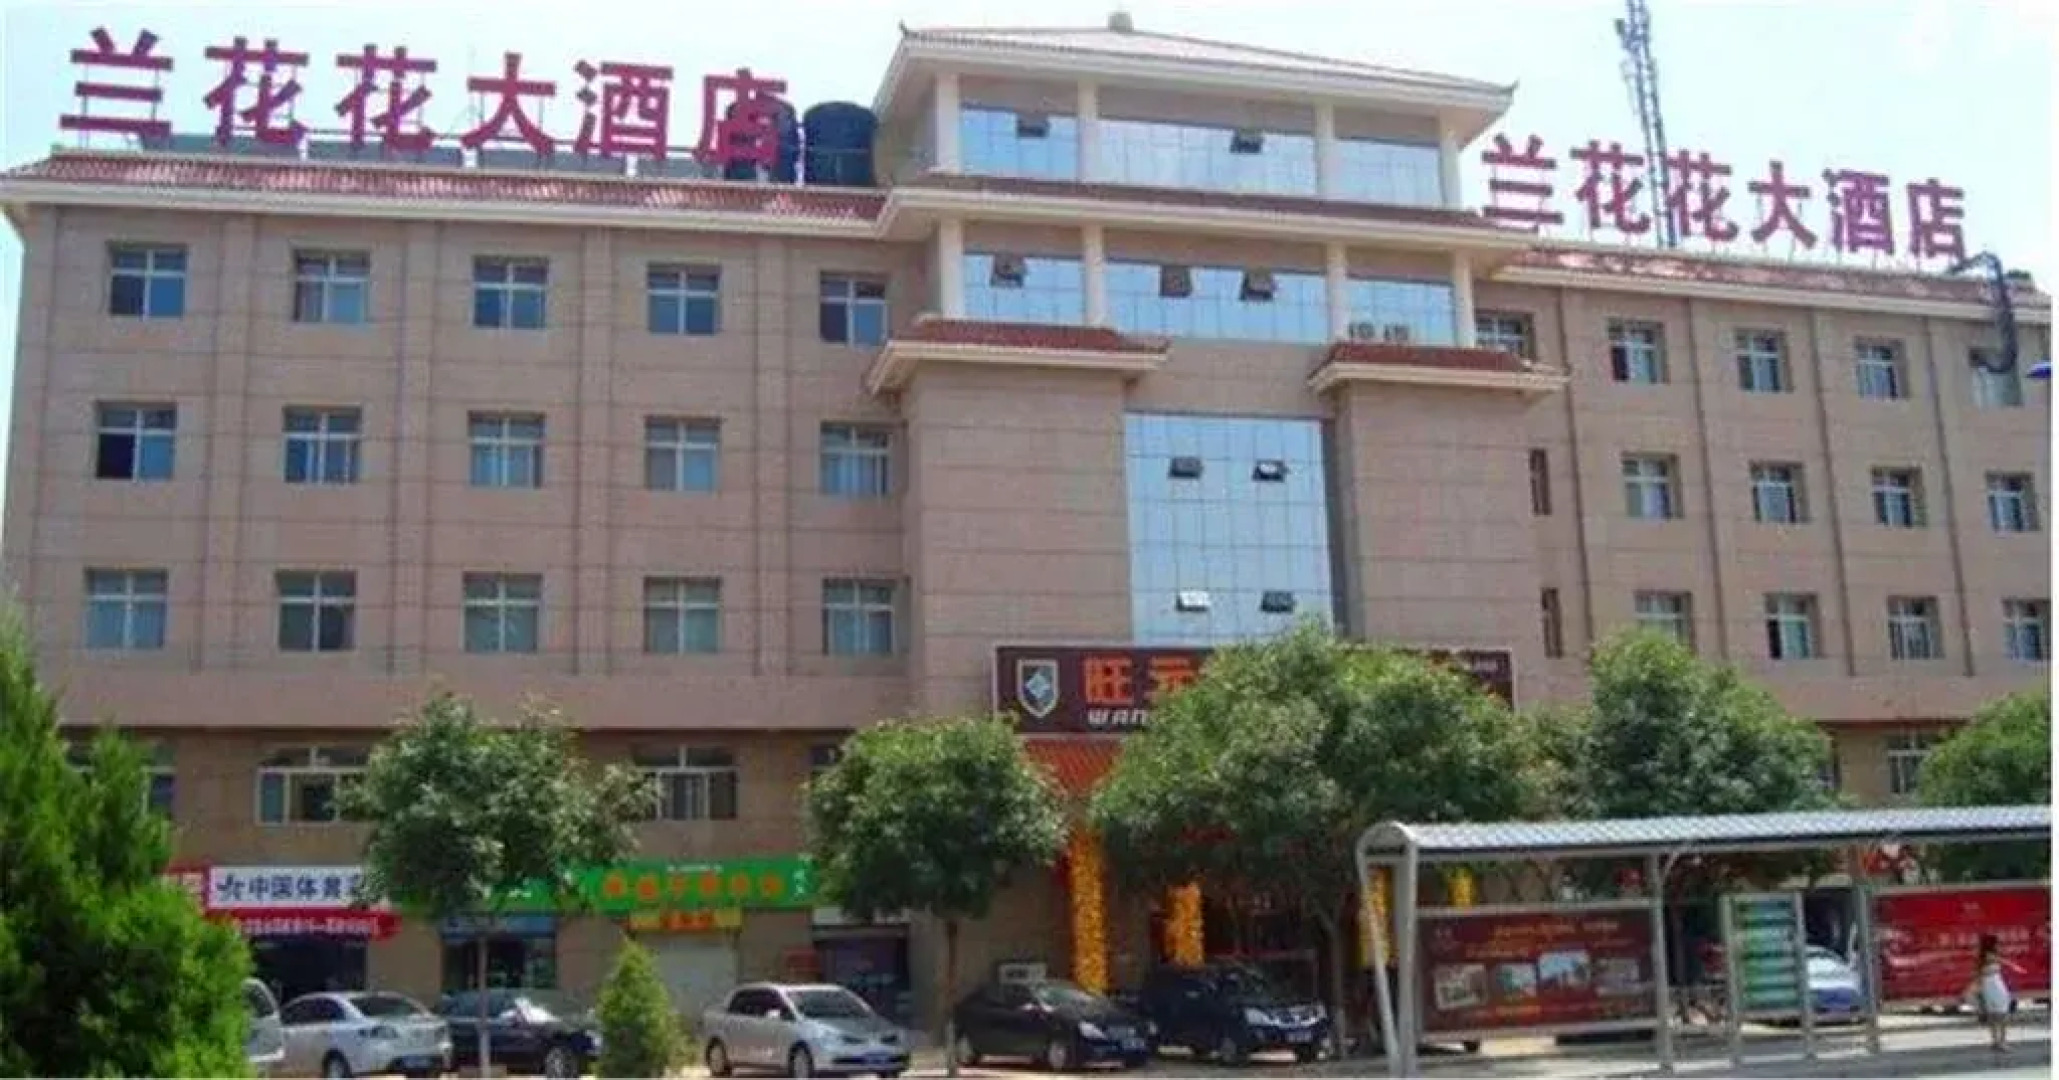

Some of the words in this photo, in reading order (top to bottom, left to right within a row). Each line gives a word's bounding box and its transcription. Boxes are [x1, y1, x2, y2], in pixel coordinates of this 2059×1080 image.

[60, 27, 788, 166] 兰花花大酒店
[1481, 134, 1966, 259] 兰花花大酒店
